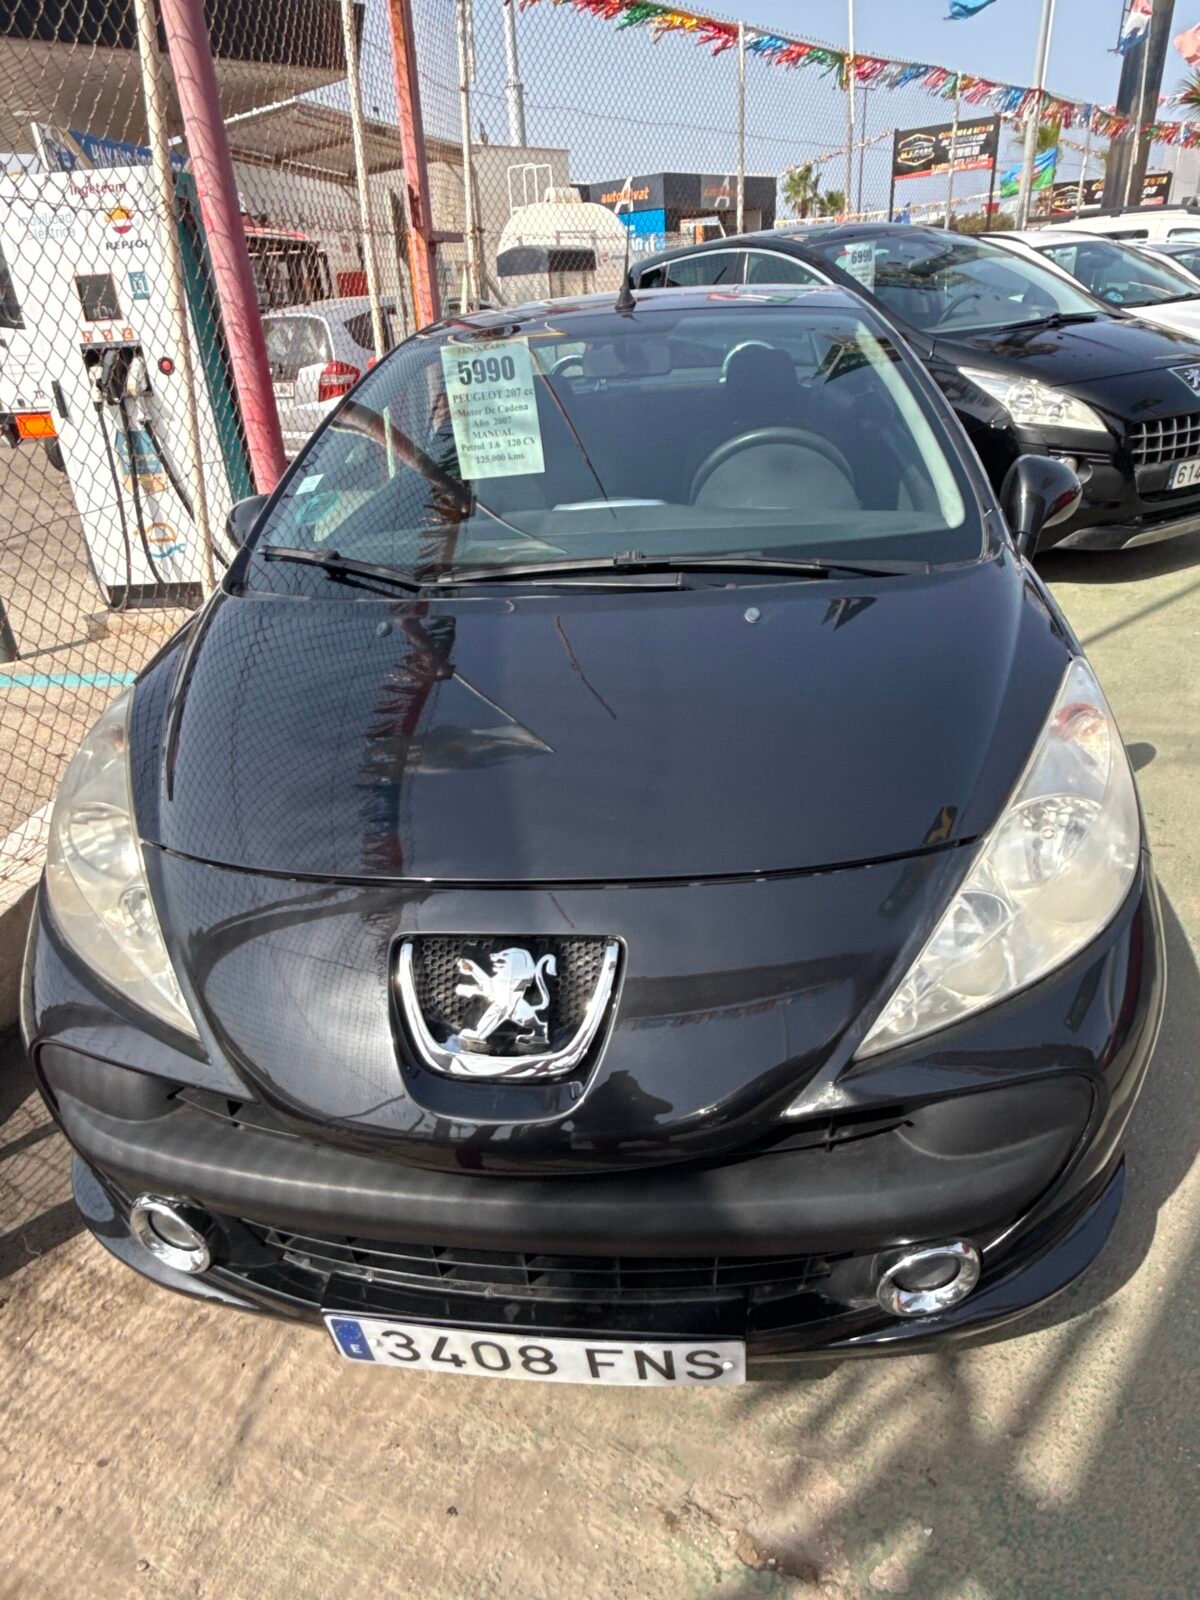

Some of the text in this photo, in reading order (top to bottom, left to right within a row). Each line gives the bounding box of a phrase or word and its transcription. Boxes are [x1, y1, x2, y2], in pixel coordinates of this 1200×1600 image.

[106, 239, 150, 250] REPSOL
[851, 250, 873, 264] 6990
[458, 355, 515, 386] 5990
[453, 390, 503, 404] PEUGEOT
[504, 388, 522, 398] 207
[457, 403, 529, 417] Motor De Cadena
[493, 416, 512, 426] 2007
[472, 428, 515, 439] MANUAL
[461, 443, 485, 452] Petrol
[489, 441, 501, 450] 1.6
[507, 438, 521, 447] 120
[507, 452, 525, 461] kms
[350, 1343, 362, 1354] E
[381, 1330, 724, 1380] 3408 FNS
